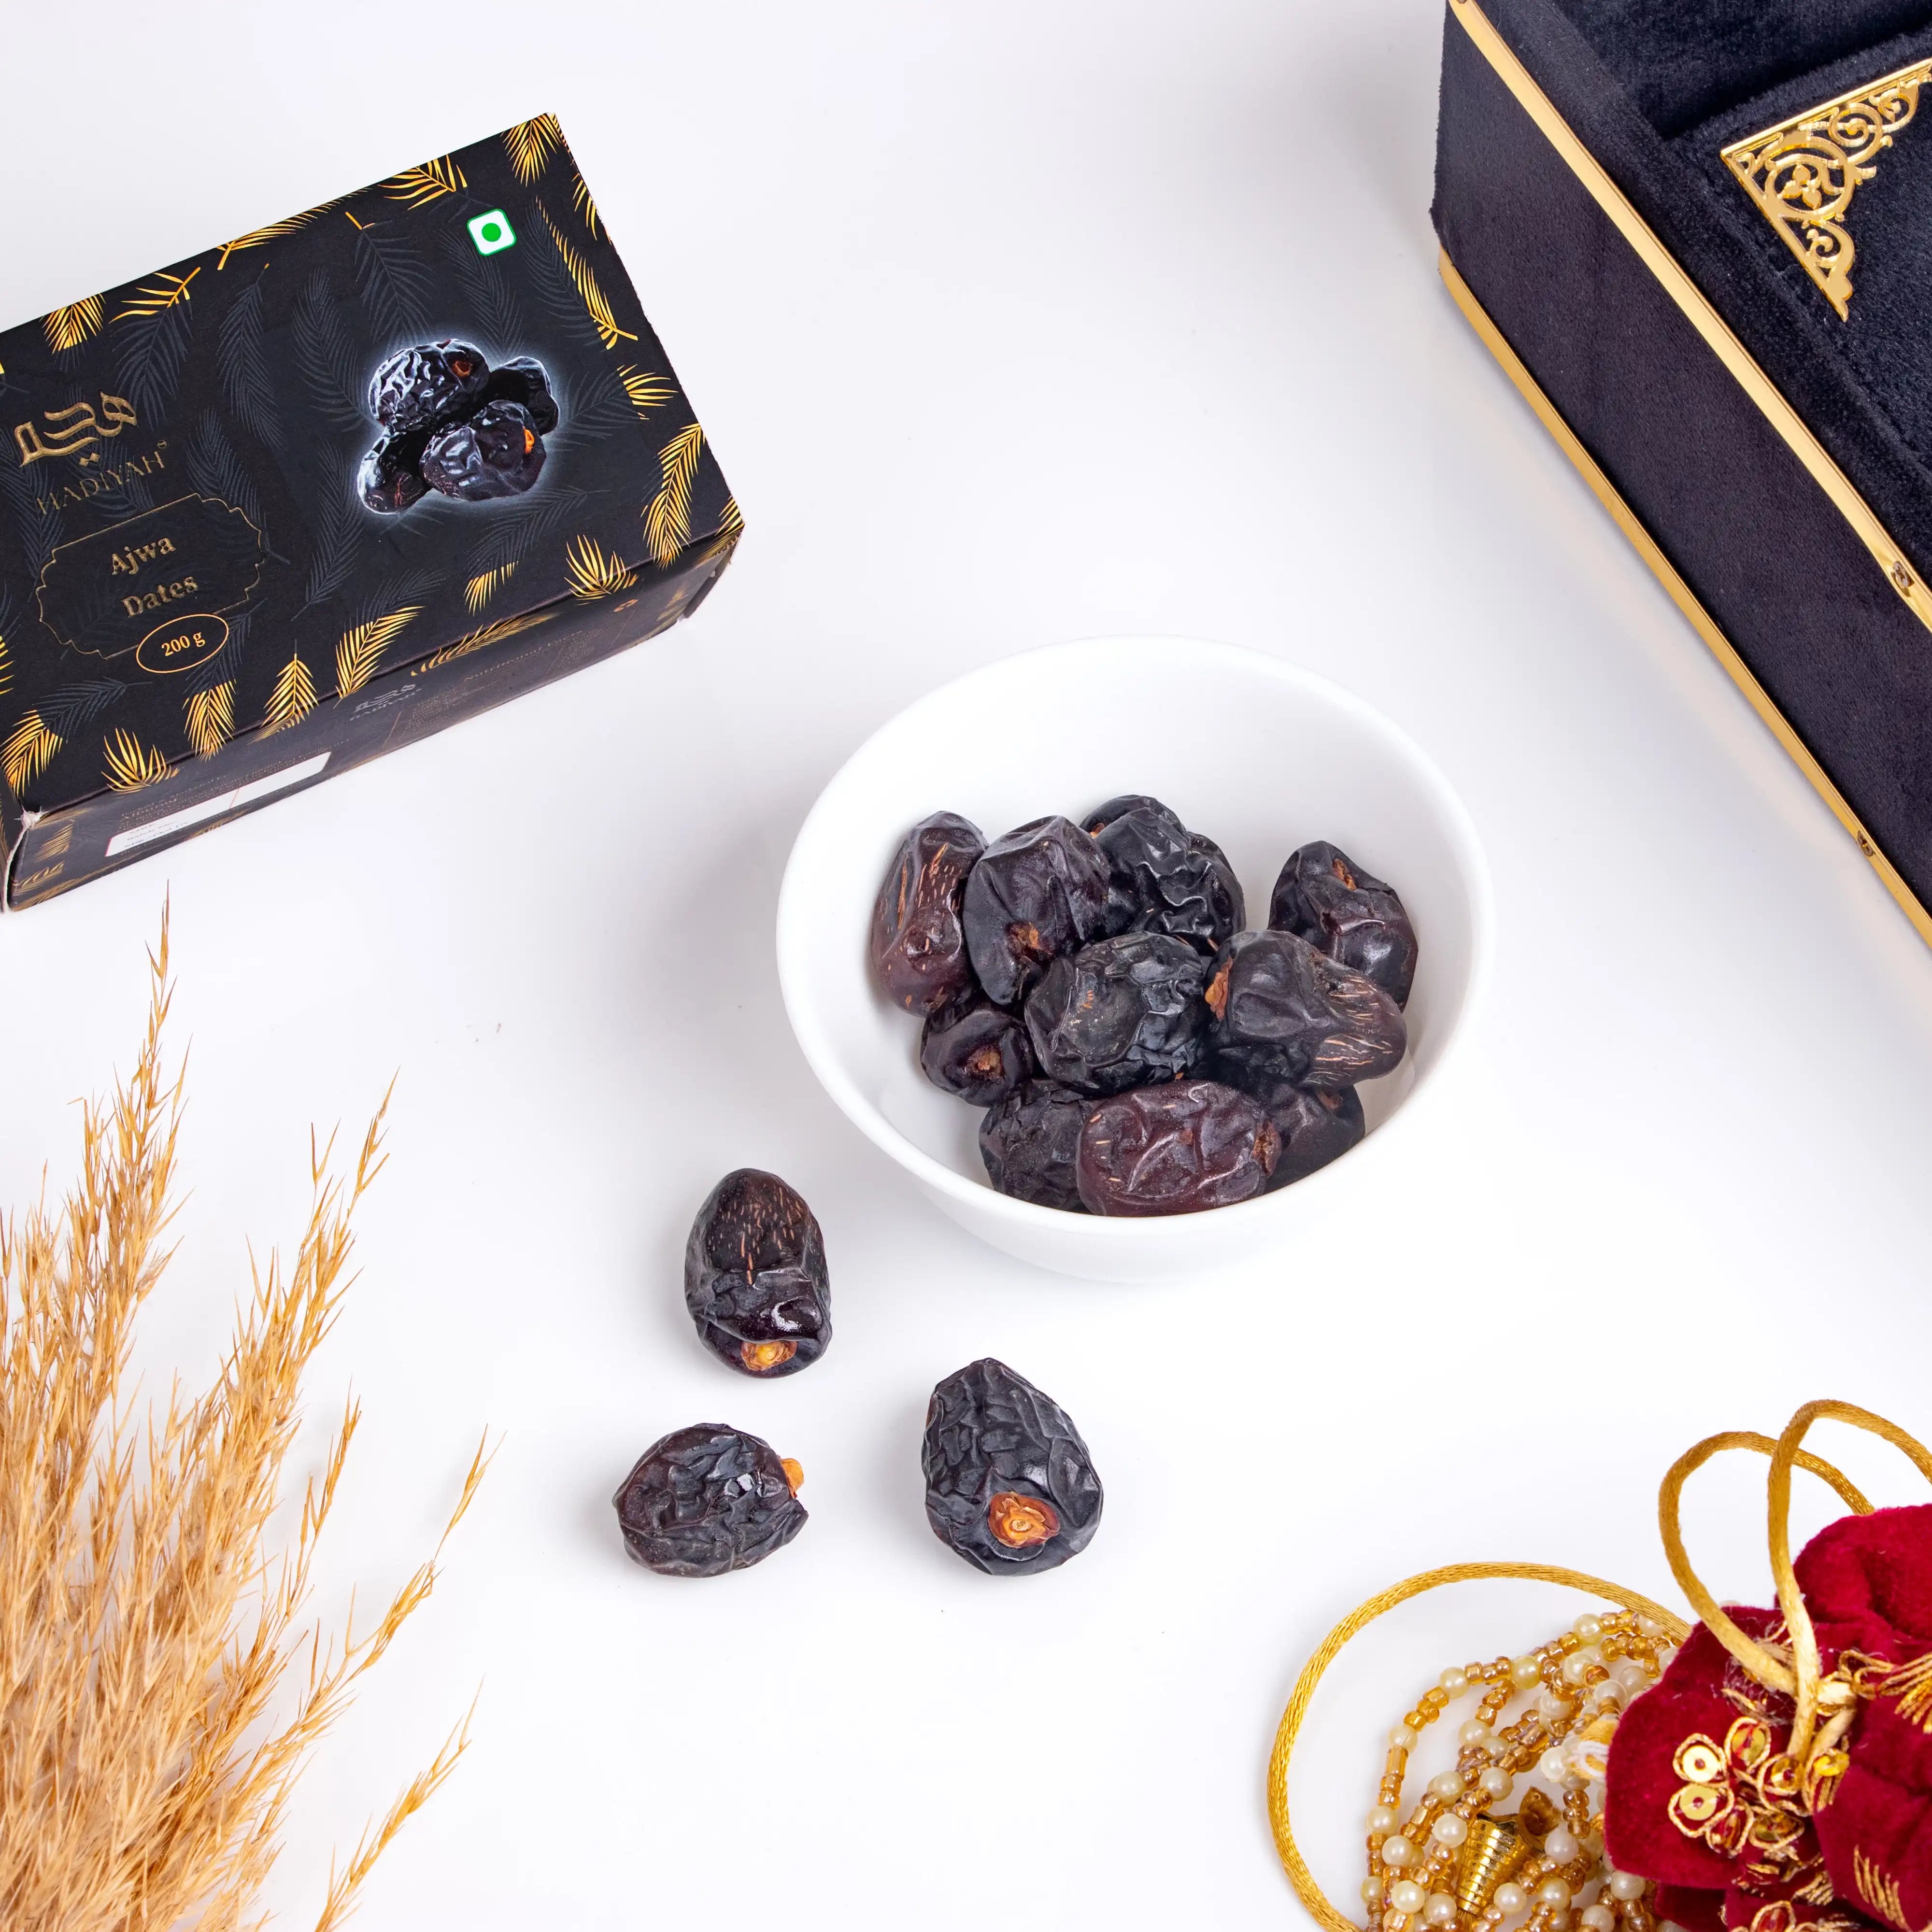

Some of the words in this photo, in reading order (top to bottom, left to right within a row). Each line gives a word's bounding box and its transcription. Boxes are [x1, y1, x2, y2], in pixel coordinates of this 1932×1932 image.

[36, 451, 166, 515] HADIYAH
[111, 537, 176, 575] Ajwa
[120, 576, 199, 619] Dates
[161, 635, 191, 657] 200
[193, 631, 206, 647] g
